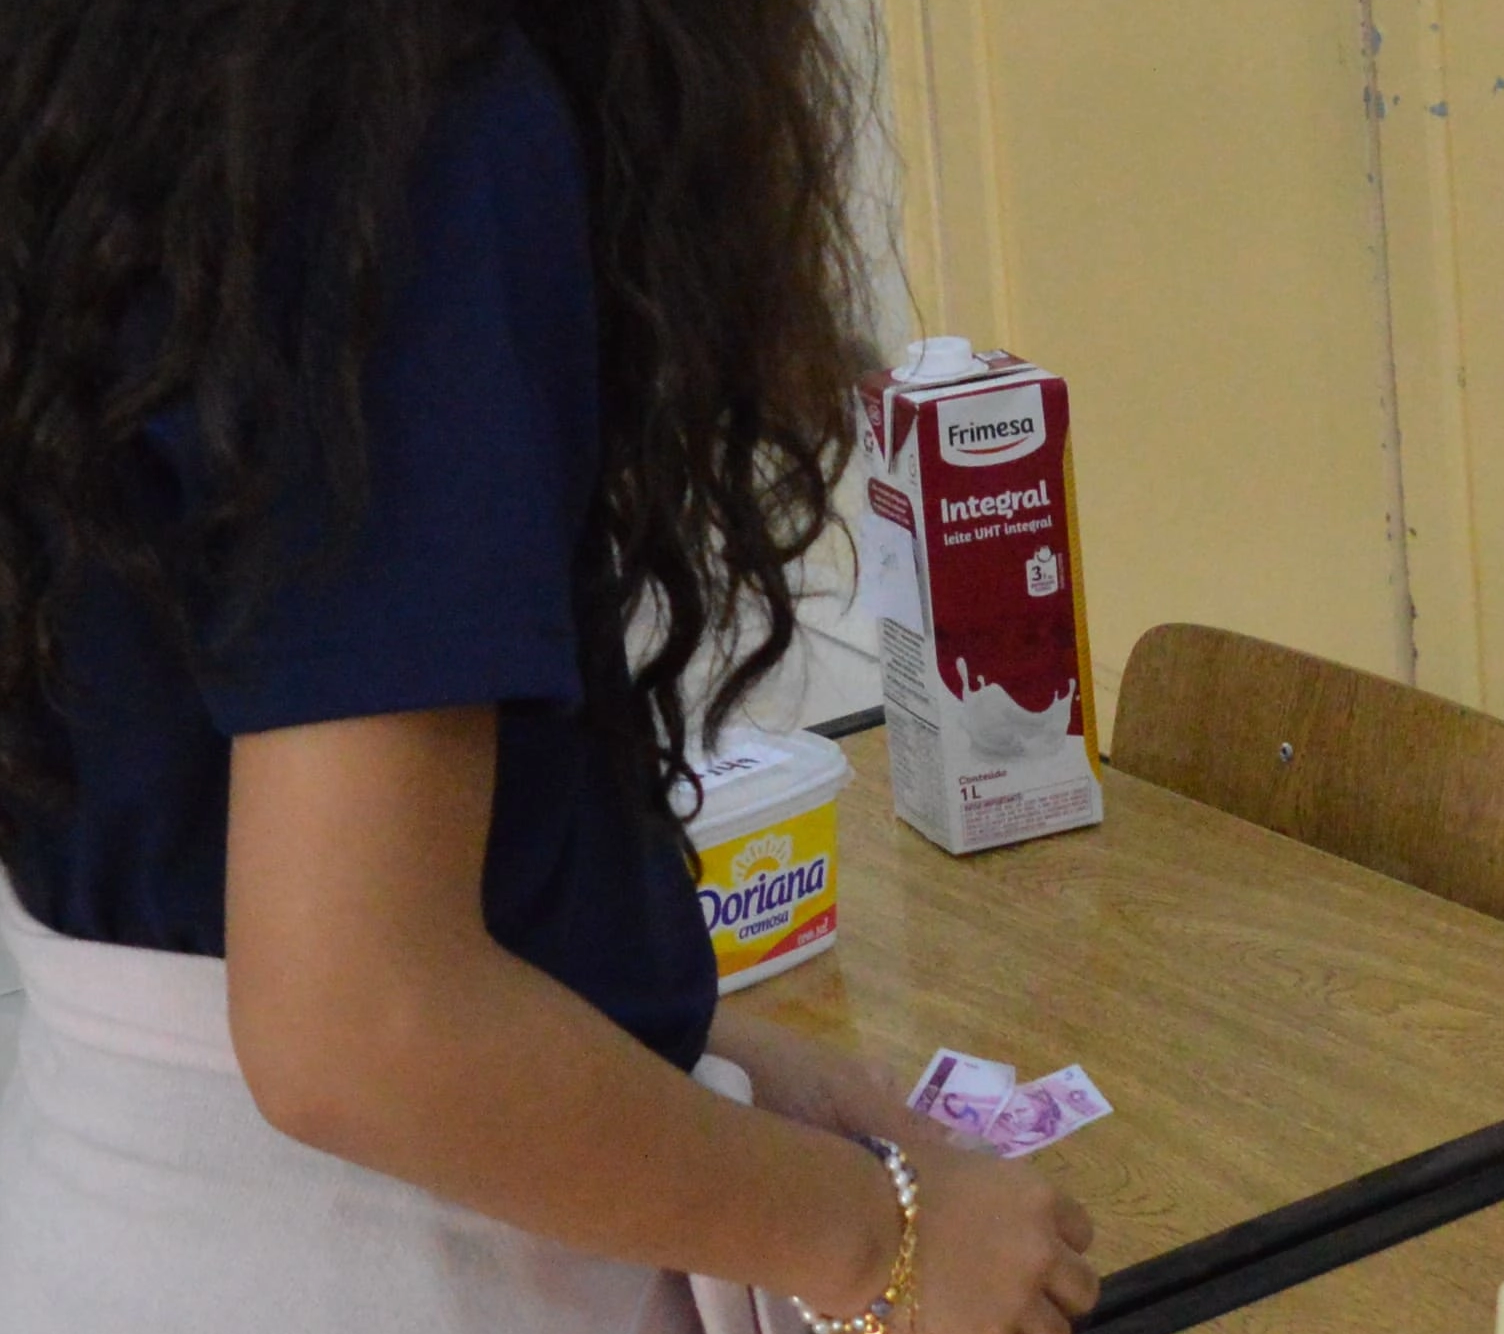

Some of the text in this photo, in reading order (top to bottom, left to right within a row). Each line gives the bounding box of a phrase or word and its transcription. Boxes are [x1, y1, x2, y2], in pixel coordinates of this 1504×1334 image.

[947, 416, 1035, 447] Frimesa
[940, 479, 1051, 524] Integral
[943, 514, 1053, 546] leite UHT integral
[960, 784, 982, 802] 1 L
[697, 858, 825, 932] Doriana
[738, 910, 789, 940] cremosa
